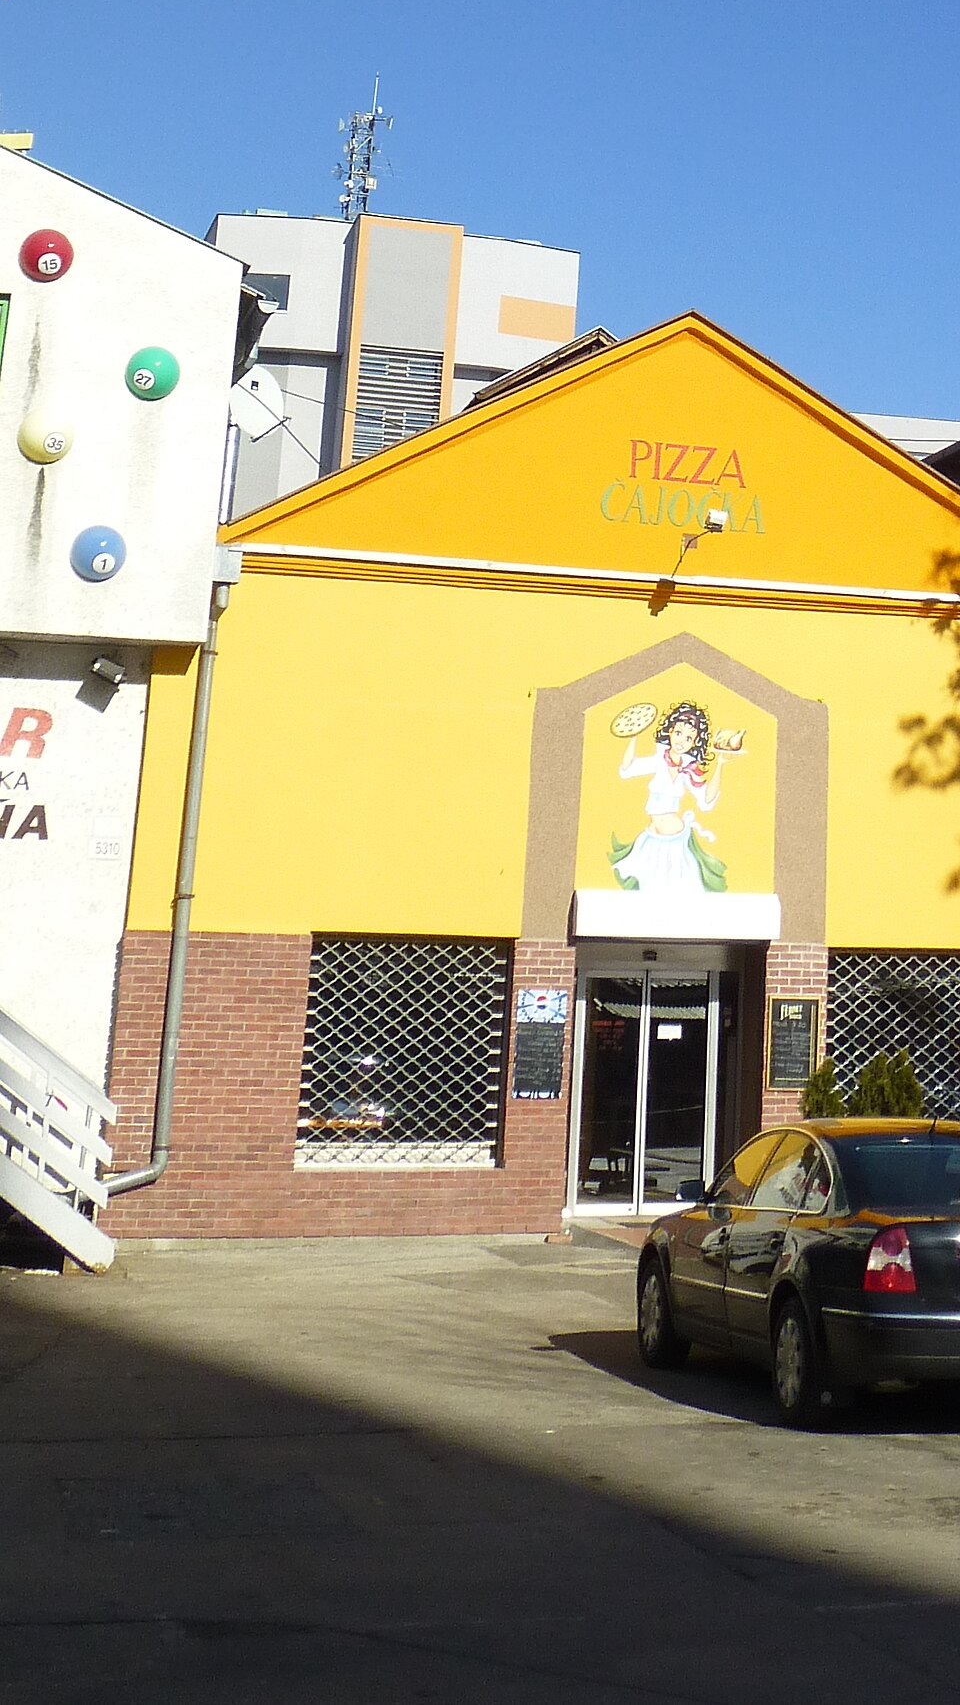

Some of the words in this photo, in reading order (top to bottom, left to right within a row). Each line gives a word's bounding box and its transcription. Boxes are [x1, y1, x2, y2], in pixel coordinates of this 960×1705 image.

[42, 259, 58, 271] 15
[135, 373, 152, 387] 27
[47, 437, 64, 451] 35
[628, 439, 746, 488] PIZZA
[100, 558, 108, 570] 1
[95, 841, 120, 855] 5310
